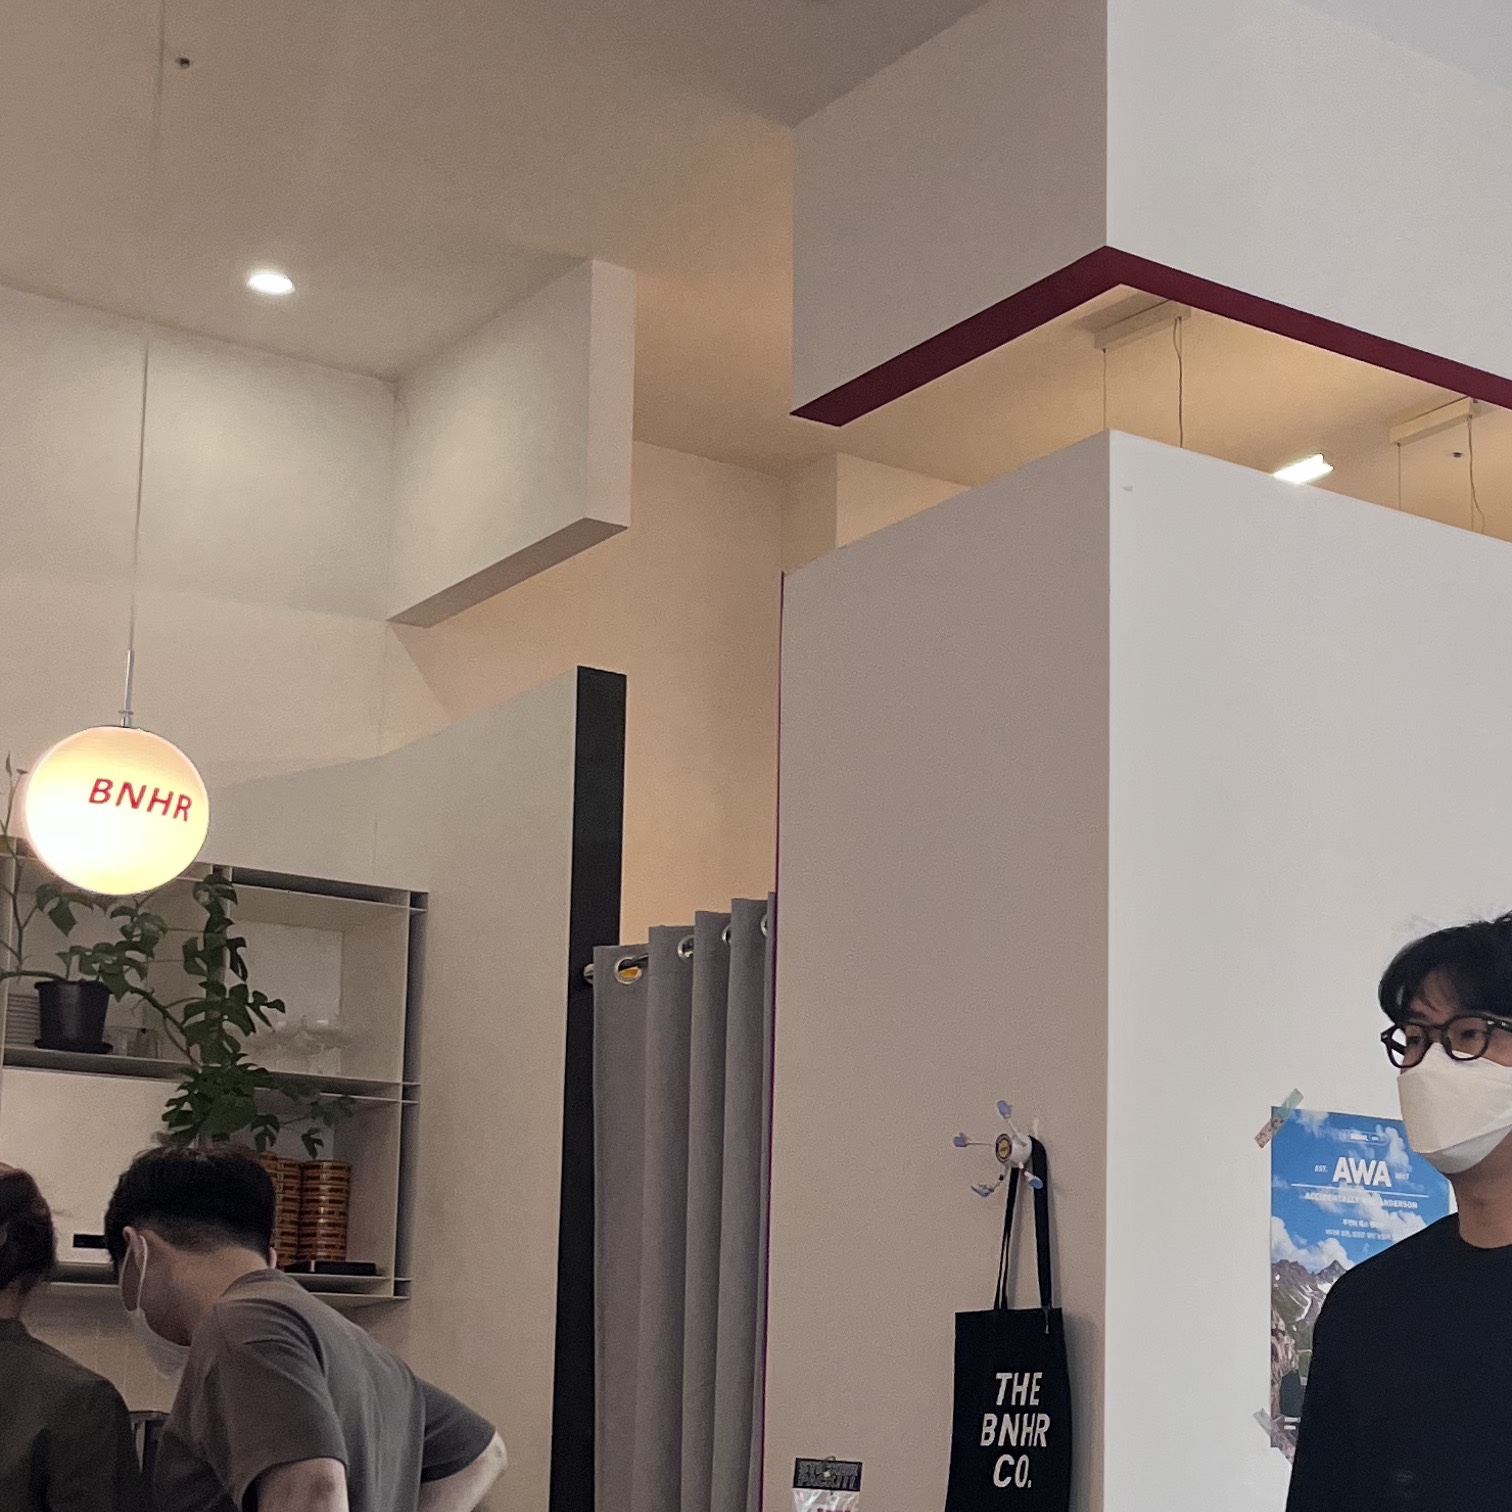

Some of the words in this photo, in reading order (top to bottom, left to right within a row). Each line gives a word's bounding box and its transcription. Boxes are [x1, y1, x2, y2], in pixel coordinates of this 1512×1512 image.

[88, 778, 192, 822] BNHR
[1332, 1156, 1392, 1188] AWA
[995, 1372, 1043, 1406] THE
[980, 1413, 1051, 1447] BNHR
[993, 1454, 1033, 1489] CO.
